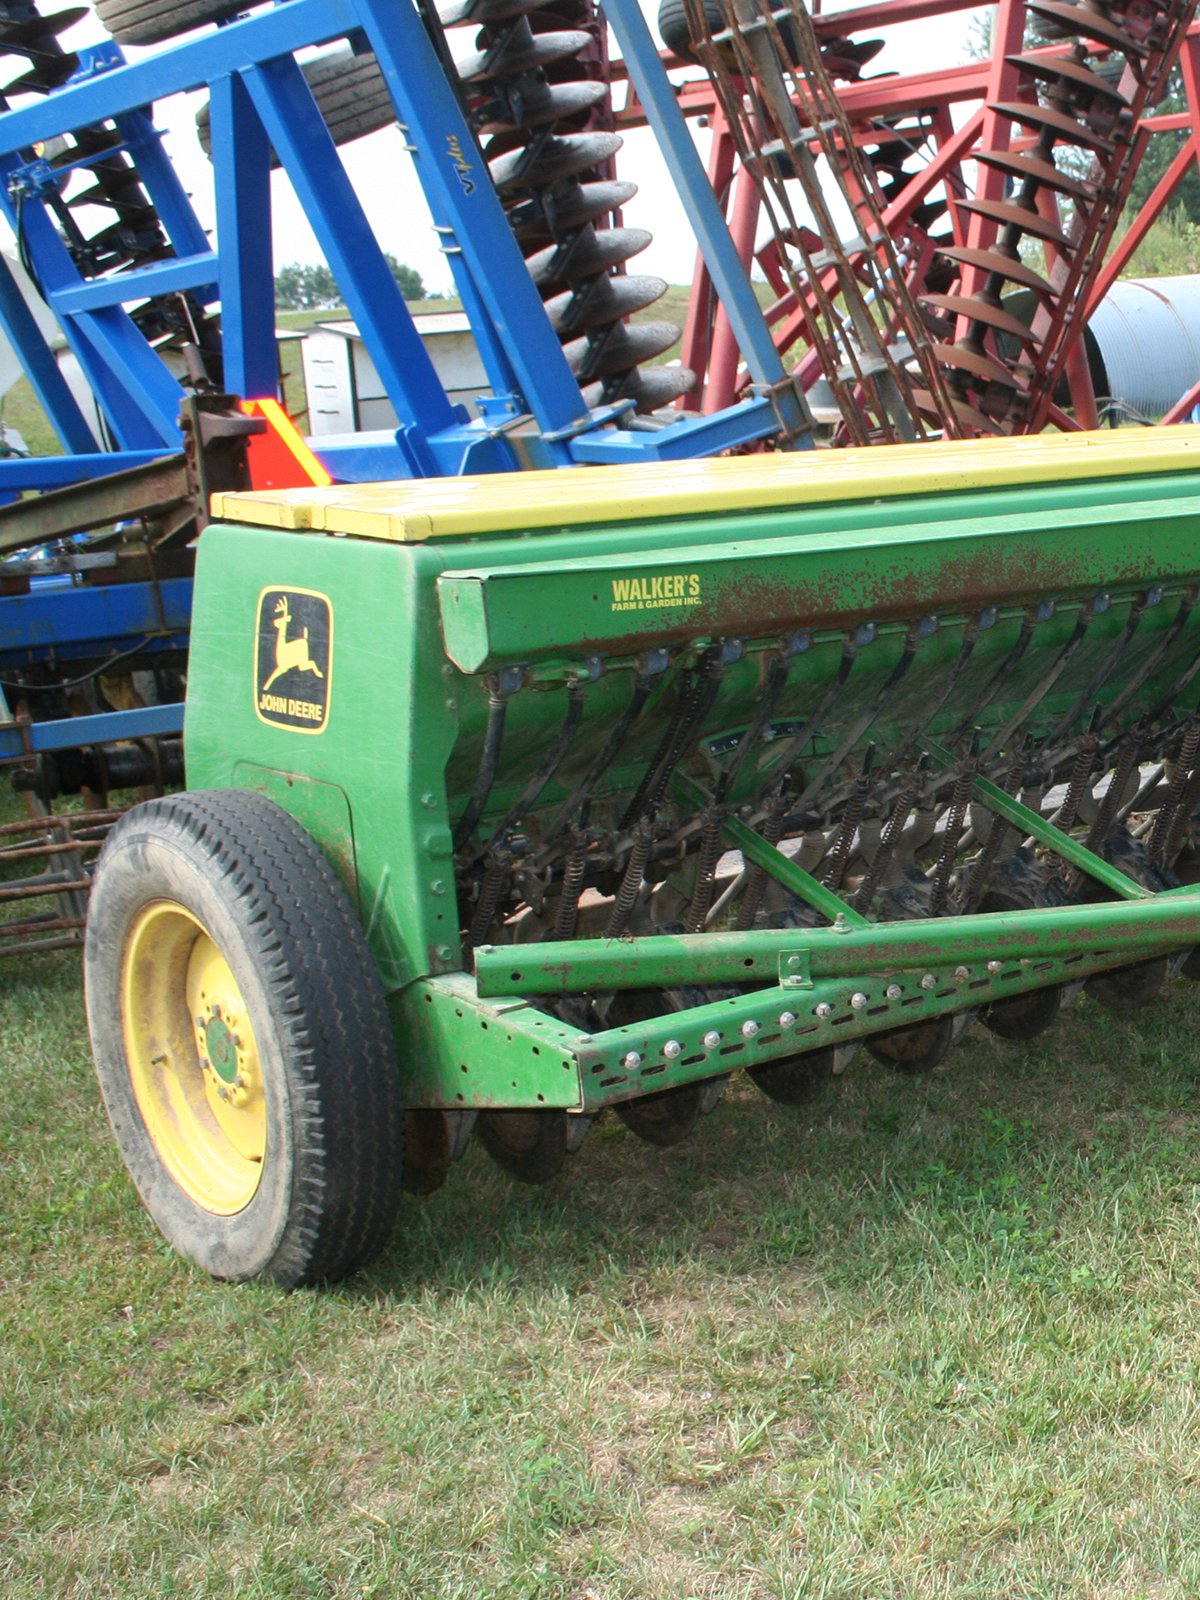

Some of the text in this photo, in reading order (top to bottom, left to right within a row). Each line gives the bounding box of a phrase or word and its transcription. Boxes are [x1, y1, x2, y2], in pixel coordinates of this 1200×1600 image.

[612, 573, 700, 602] WALKER'S
[611, 601, 637, 612] FARM
[637, 601, 645, 610] &
[645, 598, 682, 609] GARDEN
[260, 693, 323, 722] JOHN DEERE
